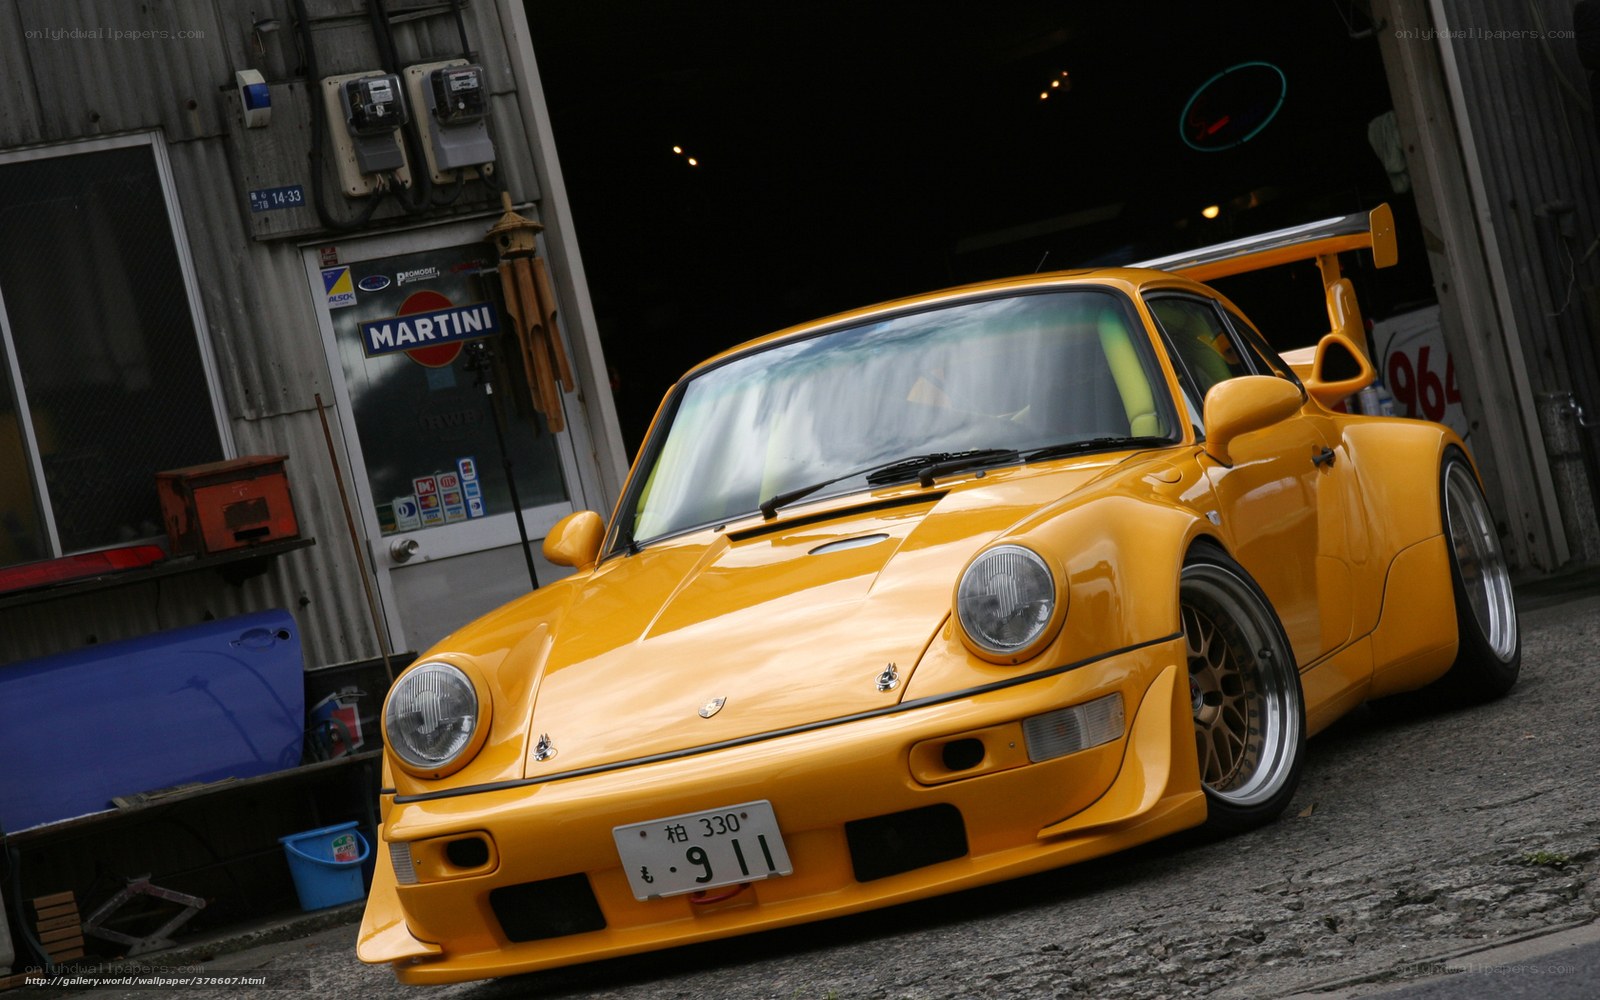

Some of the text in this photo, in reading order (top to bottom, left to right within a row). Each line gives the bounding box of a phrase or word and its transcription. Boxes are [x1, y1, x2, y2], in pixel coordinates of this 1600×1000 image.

[272, 189, 301, 204] 14-33
[328, 293, 354, 303] ALSOK
[369, 306, 493, 350] MARTINI
[664, 813, 741, 844] 柏 330
[640, 865, 654, 884] も
